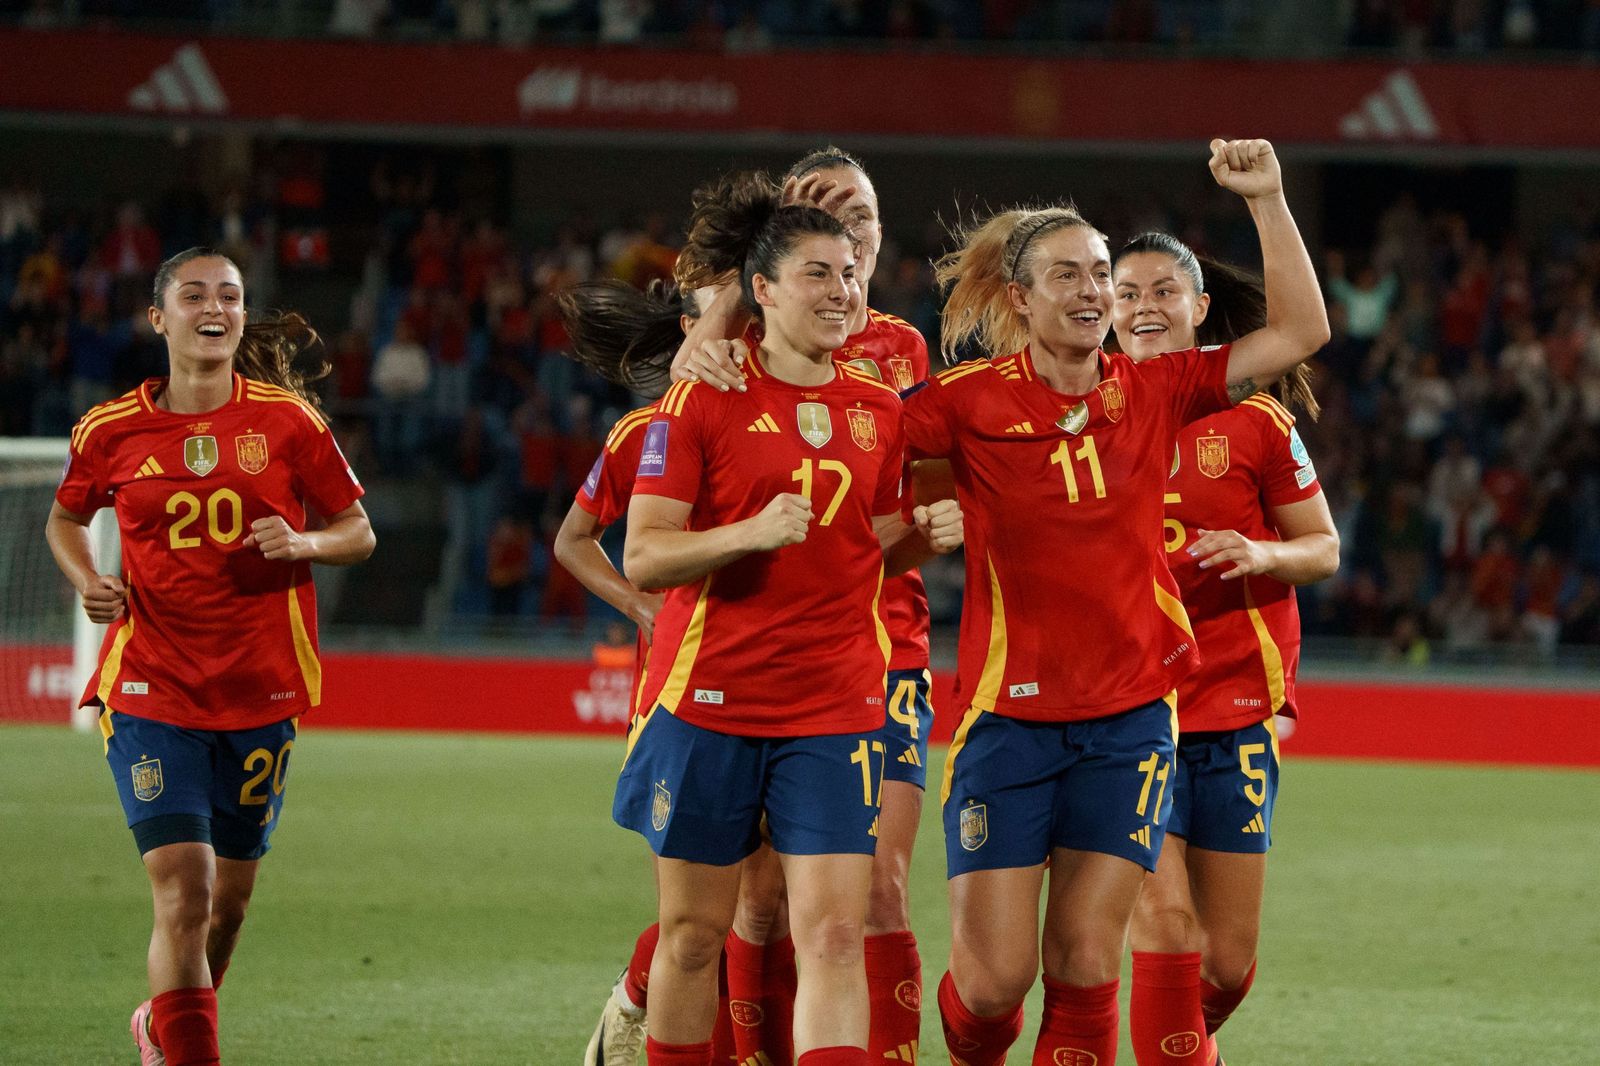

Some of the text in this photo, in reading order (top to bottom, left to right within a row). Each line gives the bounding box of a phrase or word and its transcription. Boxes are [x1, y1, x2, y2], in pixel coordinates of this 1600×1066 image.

[792, 458, 852, 526] 17
[1050, 435, 1107, 503] 11
[166, 488, 243, 550] 20
[888, 679, 920, 740] 4
[240, 740, 293, 805] 20
[1136, 751, 1171, 825] 11
[1239, 743, 1267, 807] 5
